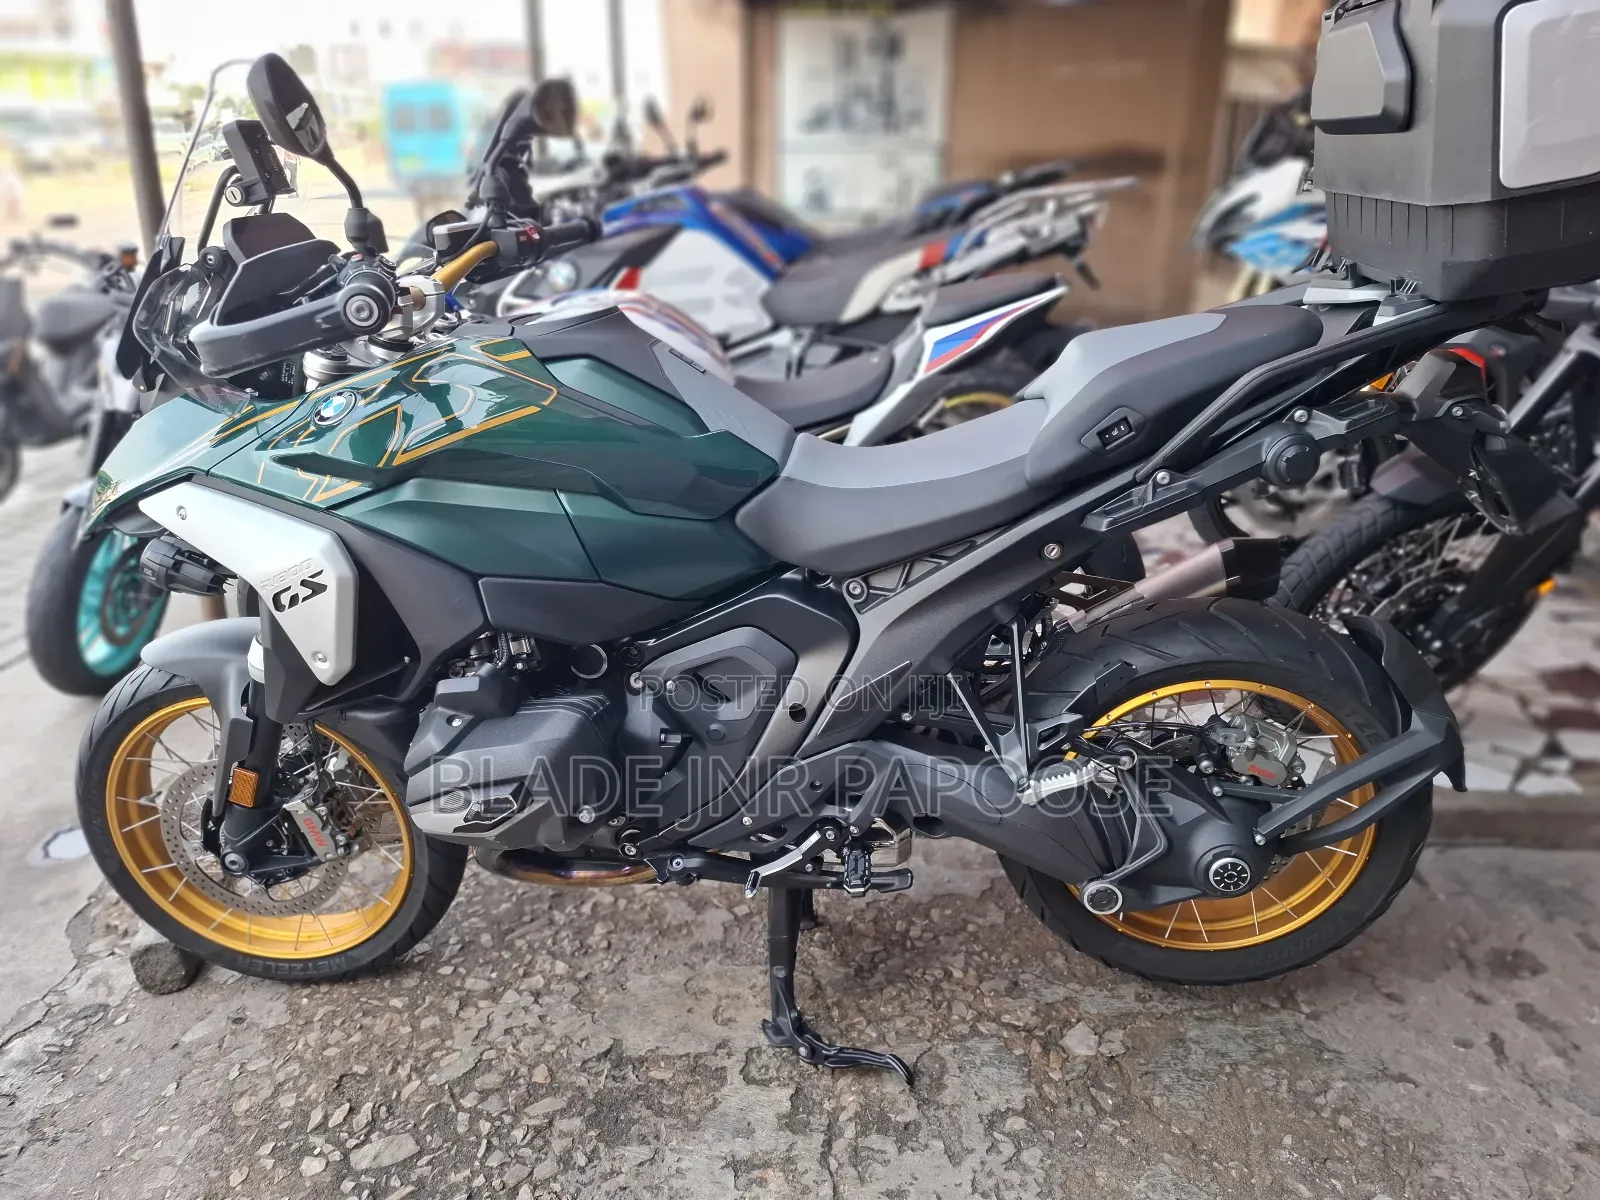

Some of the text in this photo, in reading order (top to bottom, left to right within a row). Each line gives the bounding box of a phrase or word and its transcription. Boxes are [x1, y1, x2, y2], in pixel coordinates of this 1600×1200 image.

[271, 568, 328, 613] GS
[303, 817, 328, 847] BMW
[236, 955, 346, 975] METZELER
